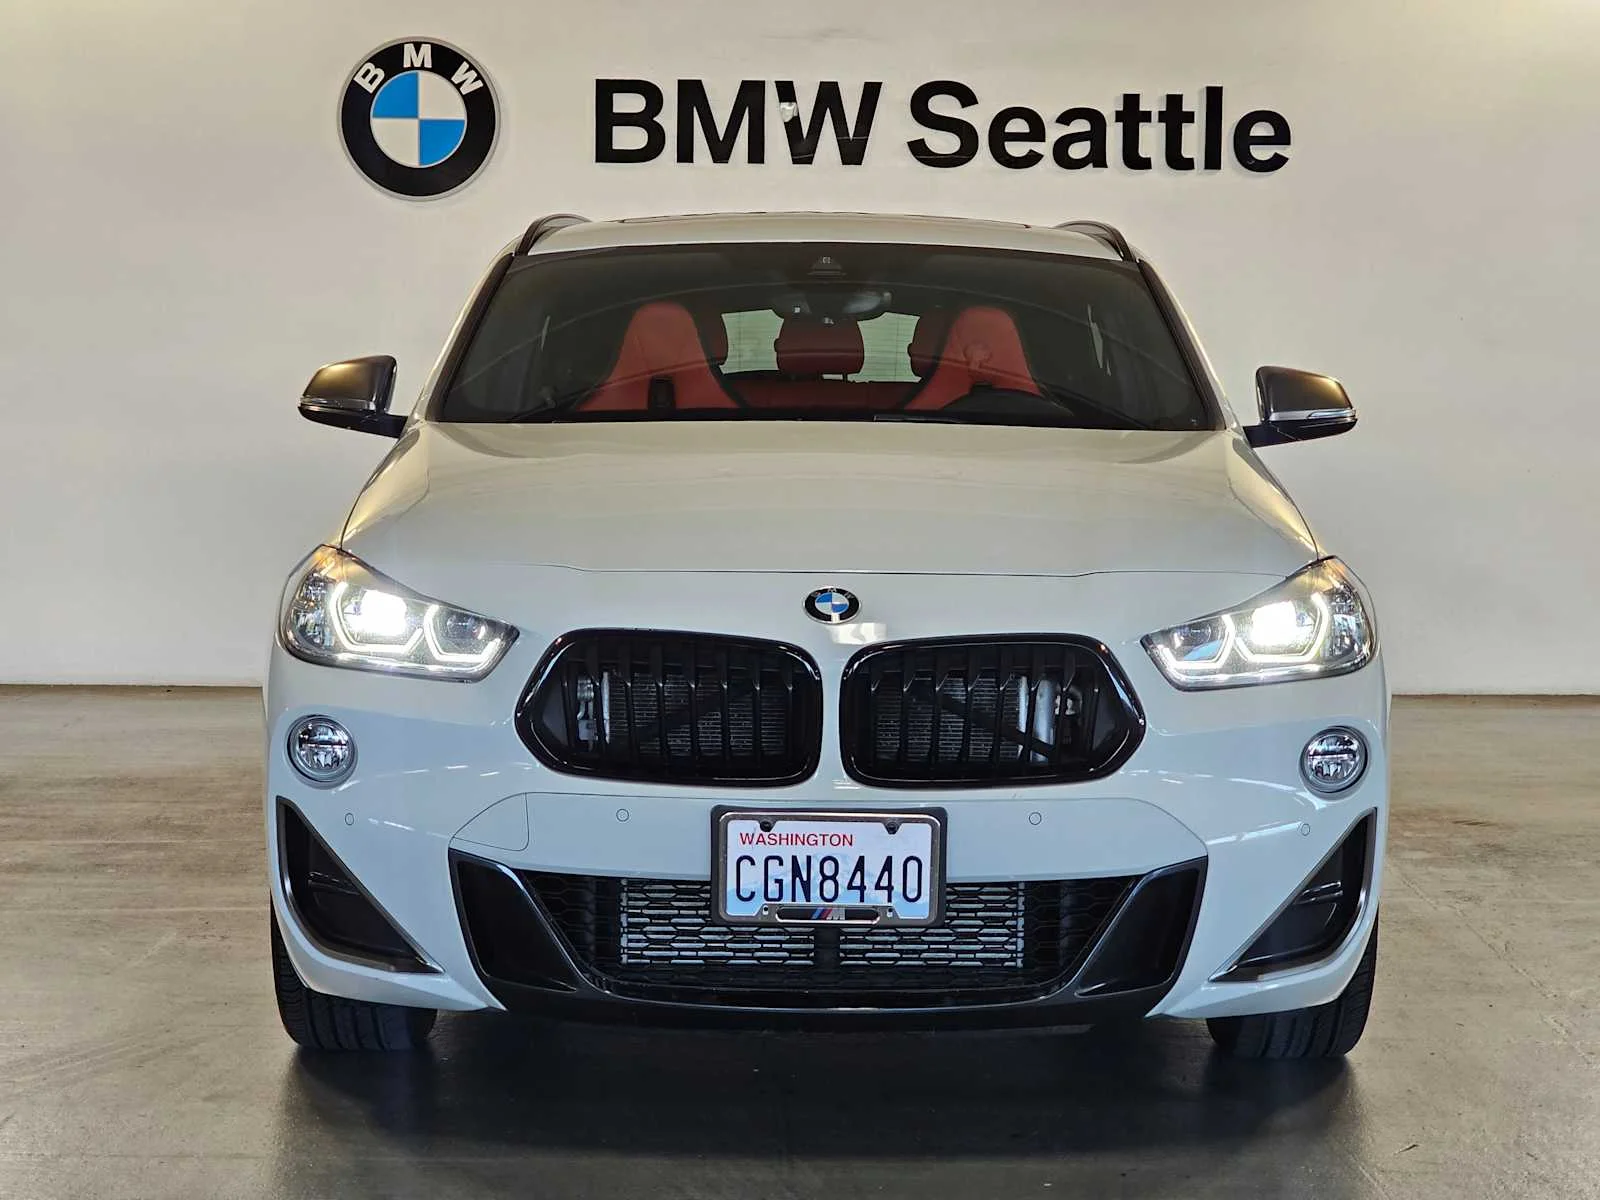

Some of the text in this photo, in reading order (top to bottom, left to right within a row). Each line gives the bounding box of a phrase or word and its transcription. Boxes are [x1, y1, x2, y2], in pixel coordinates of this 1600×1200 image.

[353, 43, 483, 96] BMW
[594, 79, 1292, 172] BMW Seattle
[739, 832, 853, 847] WASHINGTON
[735, 854, 923, 903] CGN8440
